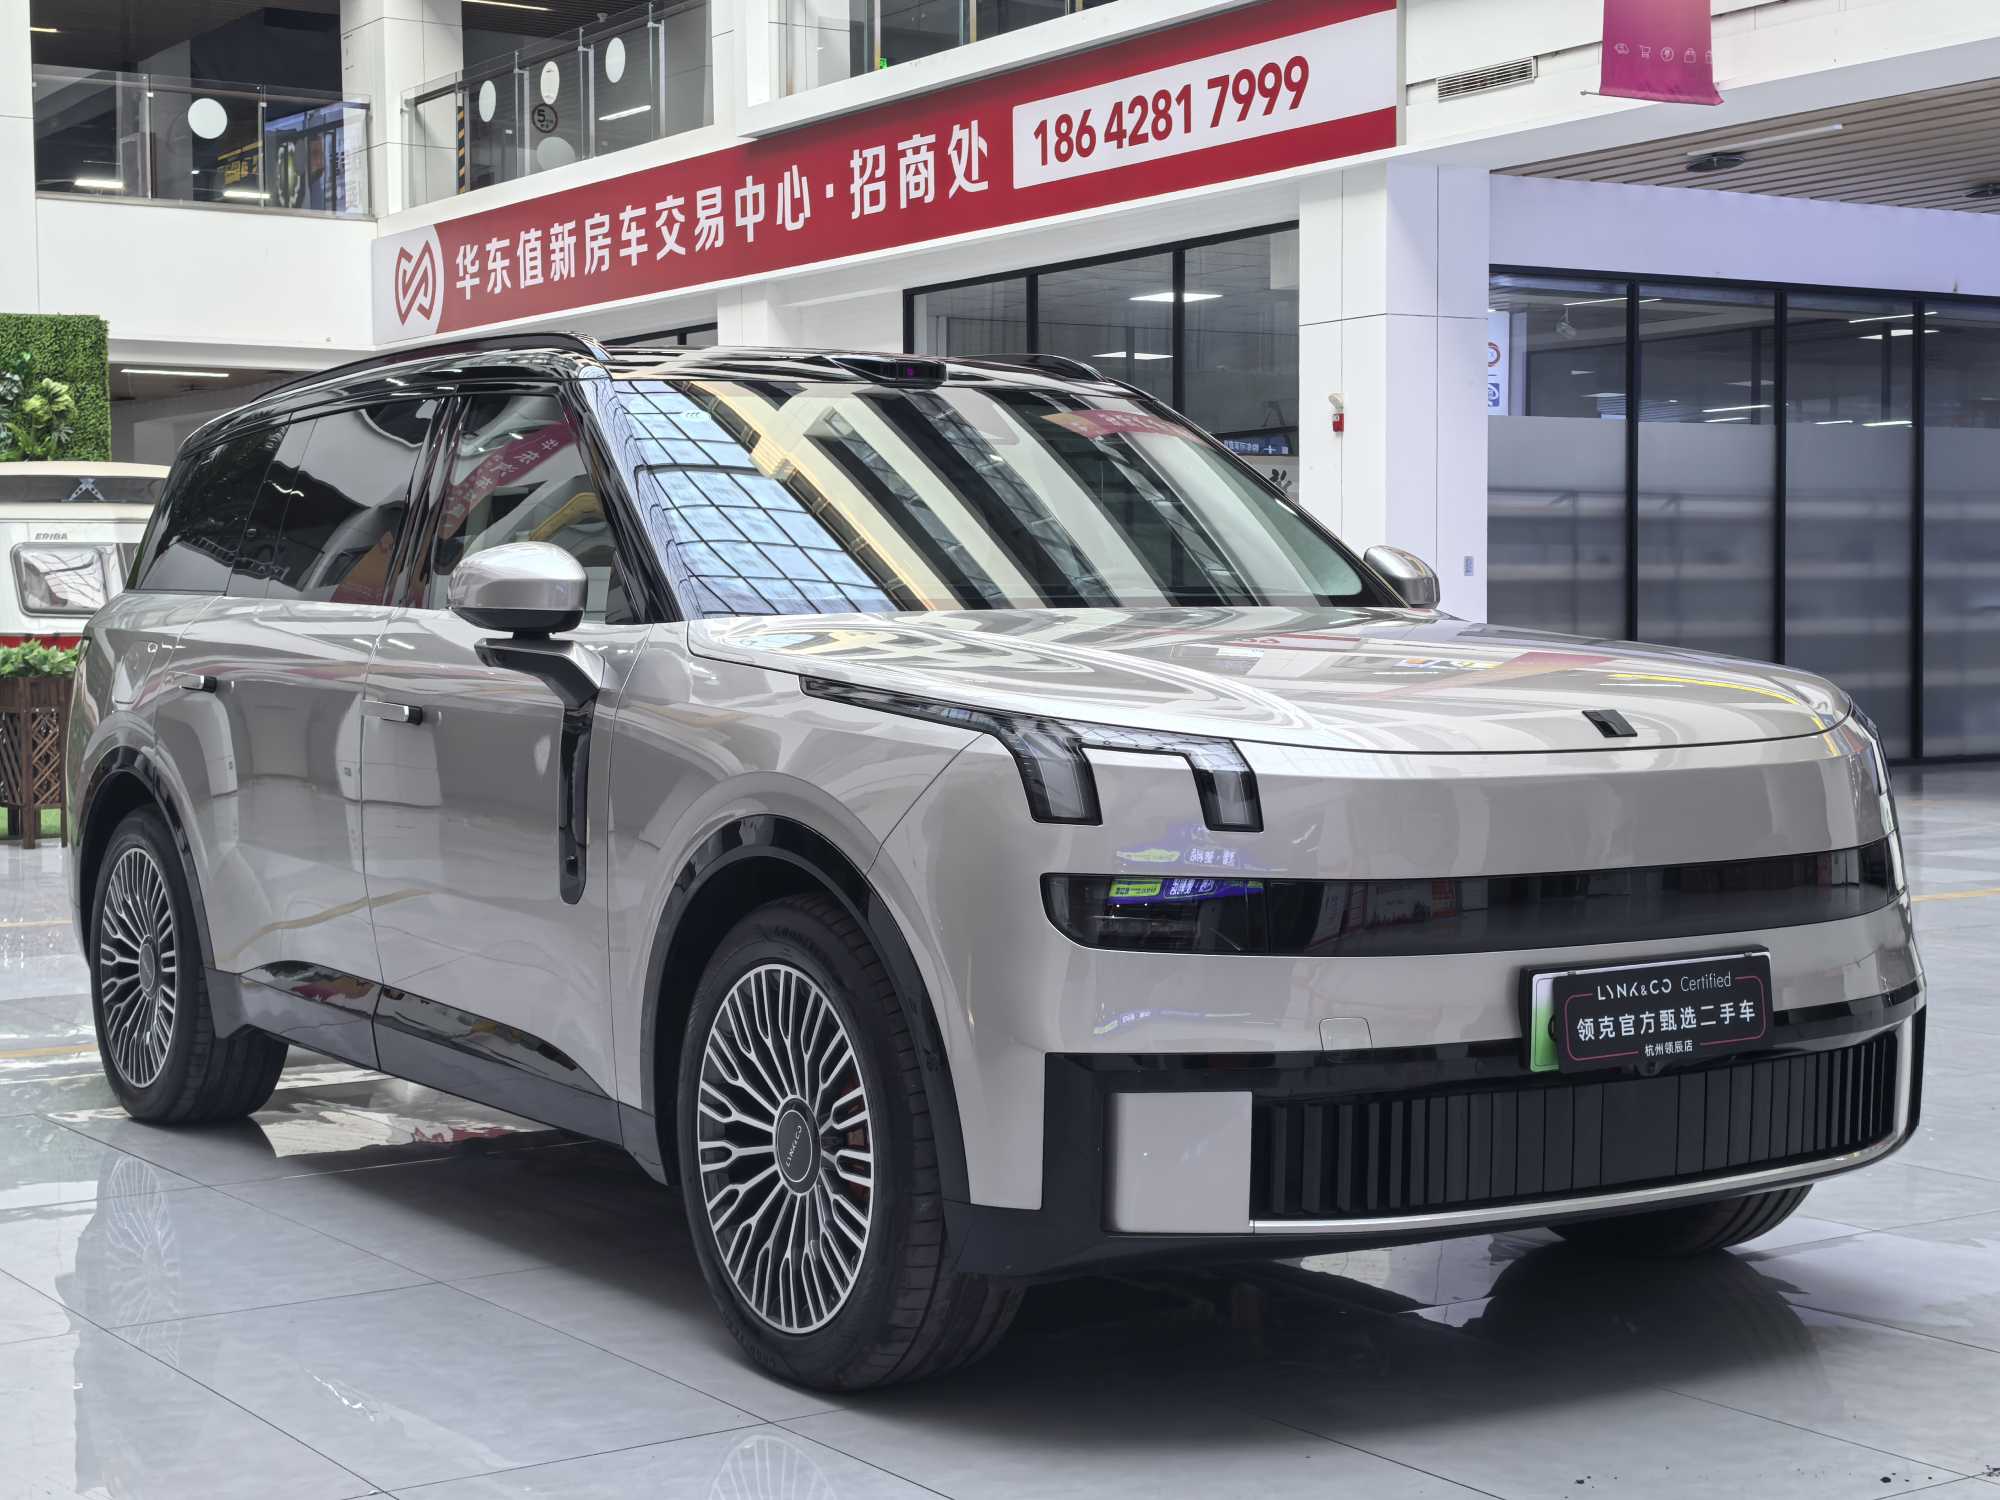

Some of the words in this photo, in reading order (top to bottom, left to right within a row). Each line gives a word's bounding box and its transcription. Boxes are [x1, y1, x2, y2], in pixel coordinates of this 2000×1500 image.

[1033, 108, 1097, 166] 186
[1104, 83, 1192, 150] 4281
[1207, 55, 1310, 128] 7999
[1680, 970, 1732, 992] Certified
[1576, 999, 1756, 1042] 领克官方甄选二手车
[1644, 1039, 1694, 1057] 杭州领辰店
